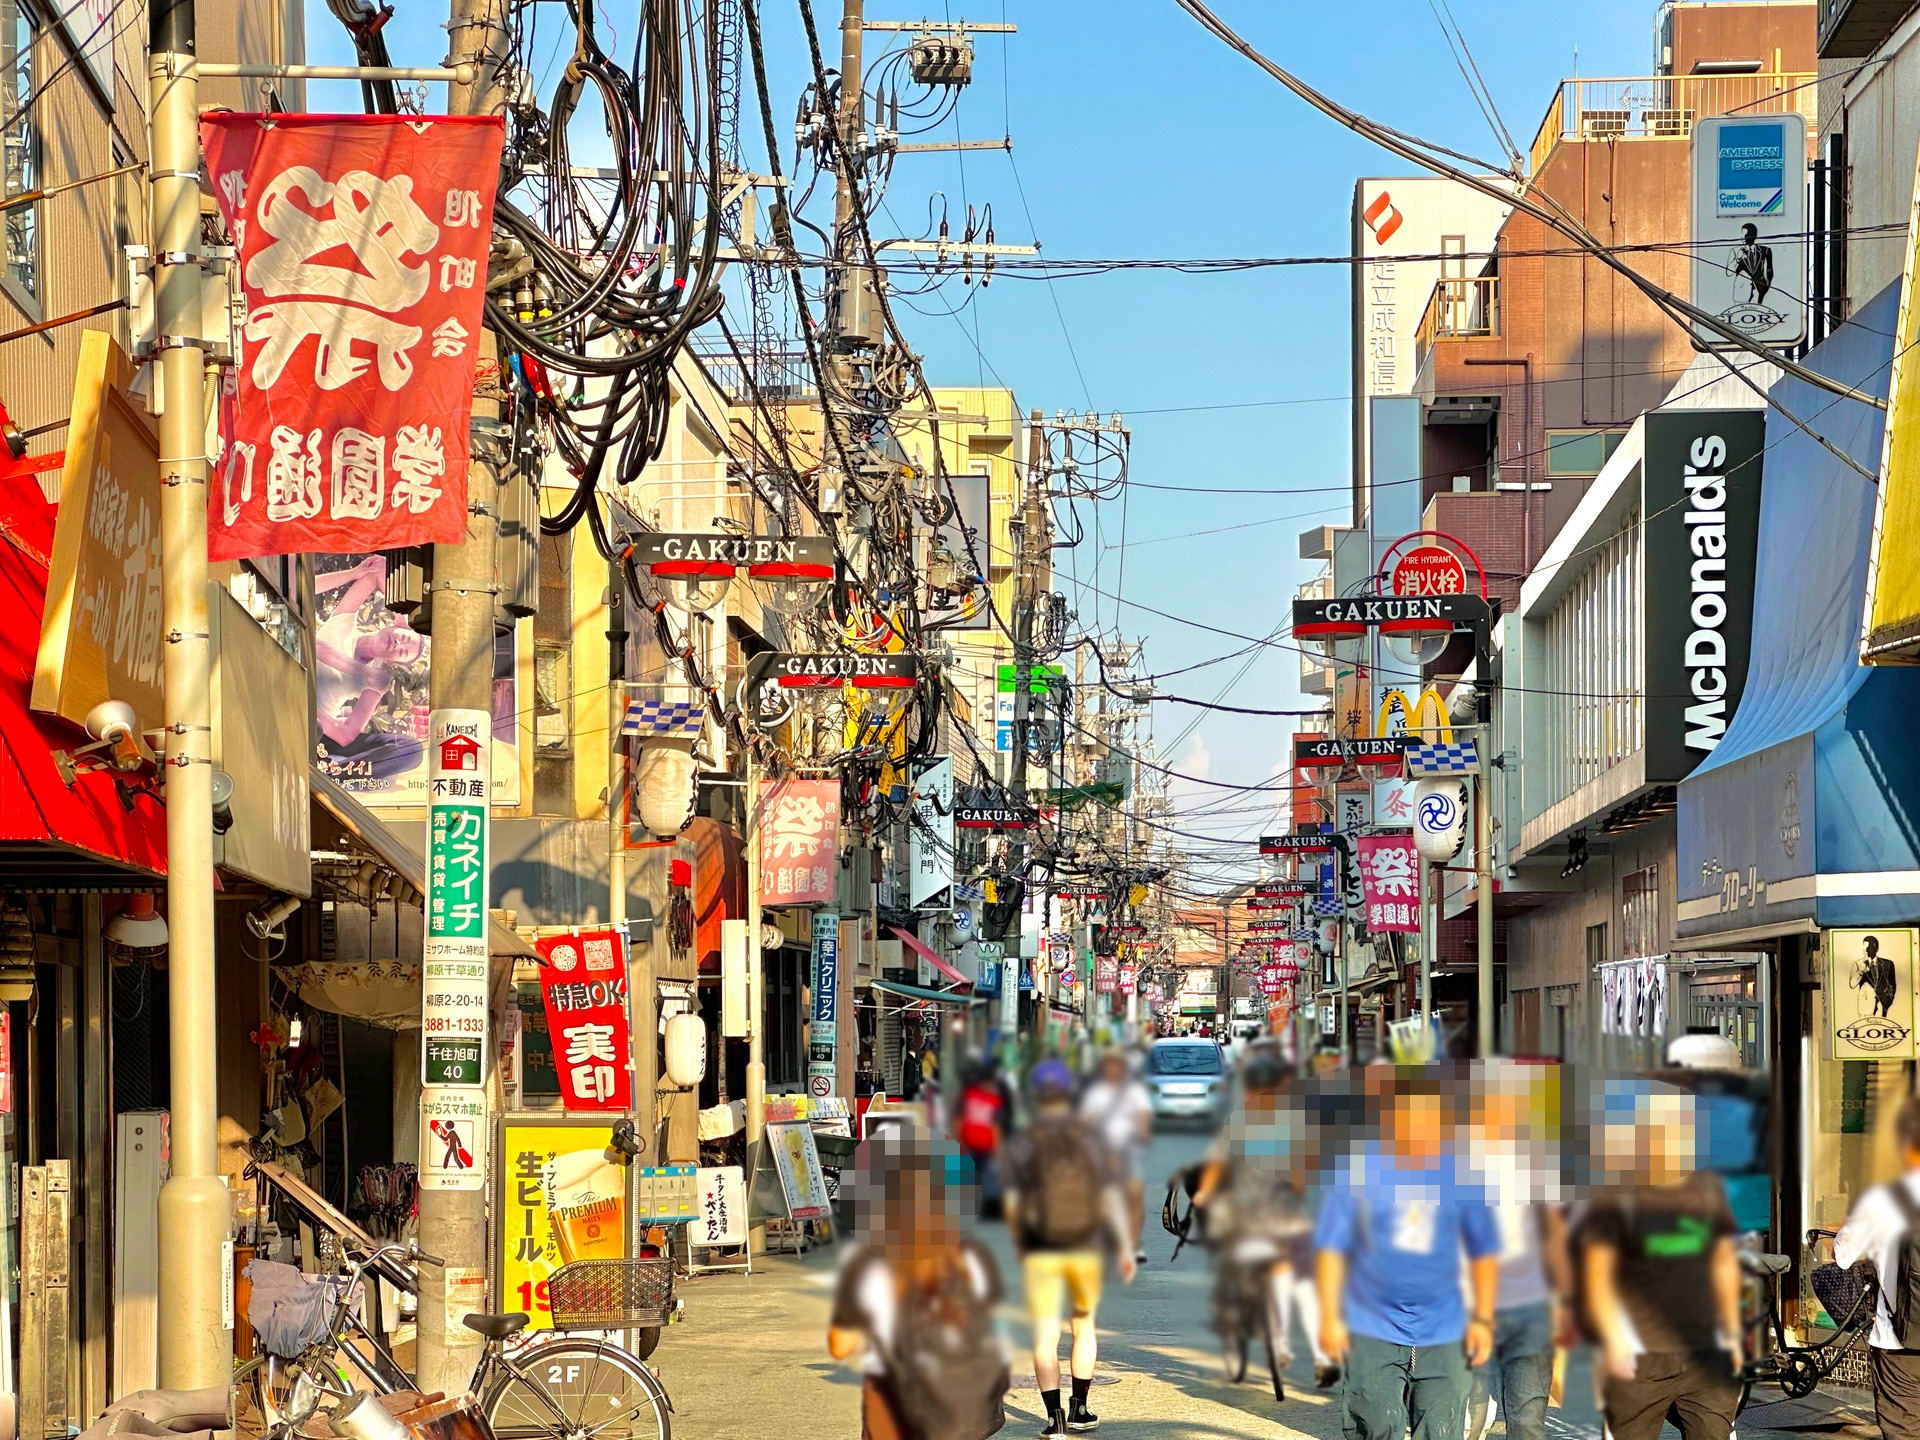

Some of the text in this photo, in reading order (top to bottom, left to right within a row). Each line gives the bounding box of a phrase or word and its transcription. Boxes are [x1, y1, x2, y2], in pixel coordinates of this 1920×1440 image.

[1719, 147, 1780, 158] AMERICAN
[1732, 158, 1783, 171] EXPRESS
[1719, 193, 1747, 201] Cards
[1719, 200, 1762, 208] Welcome
[1404, 555, 1452, 565] FIRE HYDRANT
[1400, 568, 1460, 595] 消火栓
[1684, 434, 1727, 751] McDonald's
[445, 722, 478, 738] KANEICHI
[432, 778, 484, 797] 不動産
[1381, 787, 1412, 818] 灸
[450, 810, 481, 932] カネイチ
[1371, 847, 1411, 896] 祭
[1370, 903, 1419, 926] 学園通り
[426, 944, 485, 956] ミサワホーム特約店
[820, 940, 834, 1020] 幸仁クリニック
[426, 994, 483, 1007] 柳原2-20-14
[549, 977, 626, 1012] 特急OK
[425, 1018, 483, 1032] 3881-1333
[1836, 1028, 1911, 1039] GLORY
[429, 1048, 479, 1061] 千住旭町
[563, 1022, 616, 1103] 実印
[443, 1065, 463, 1079] 40
[423, 1103, 483, 1115] ながらスマホ禁止
[572, 1191, 600, 1204] The
[515, 1151, 544, 1262] 生ビール
[547, 1151, 557, 1261] ザ・プレミアム・モルツ
[560, 1197, 617, 1221] PREMIUM
